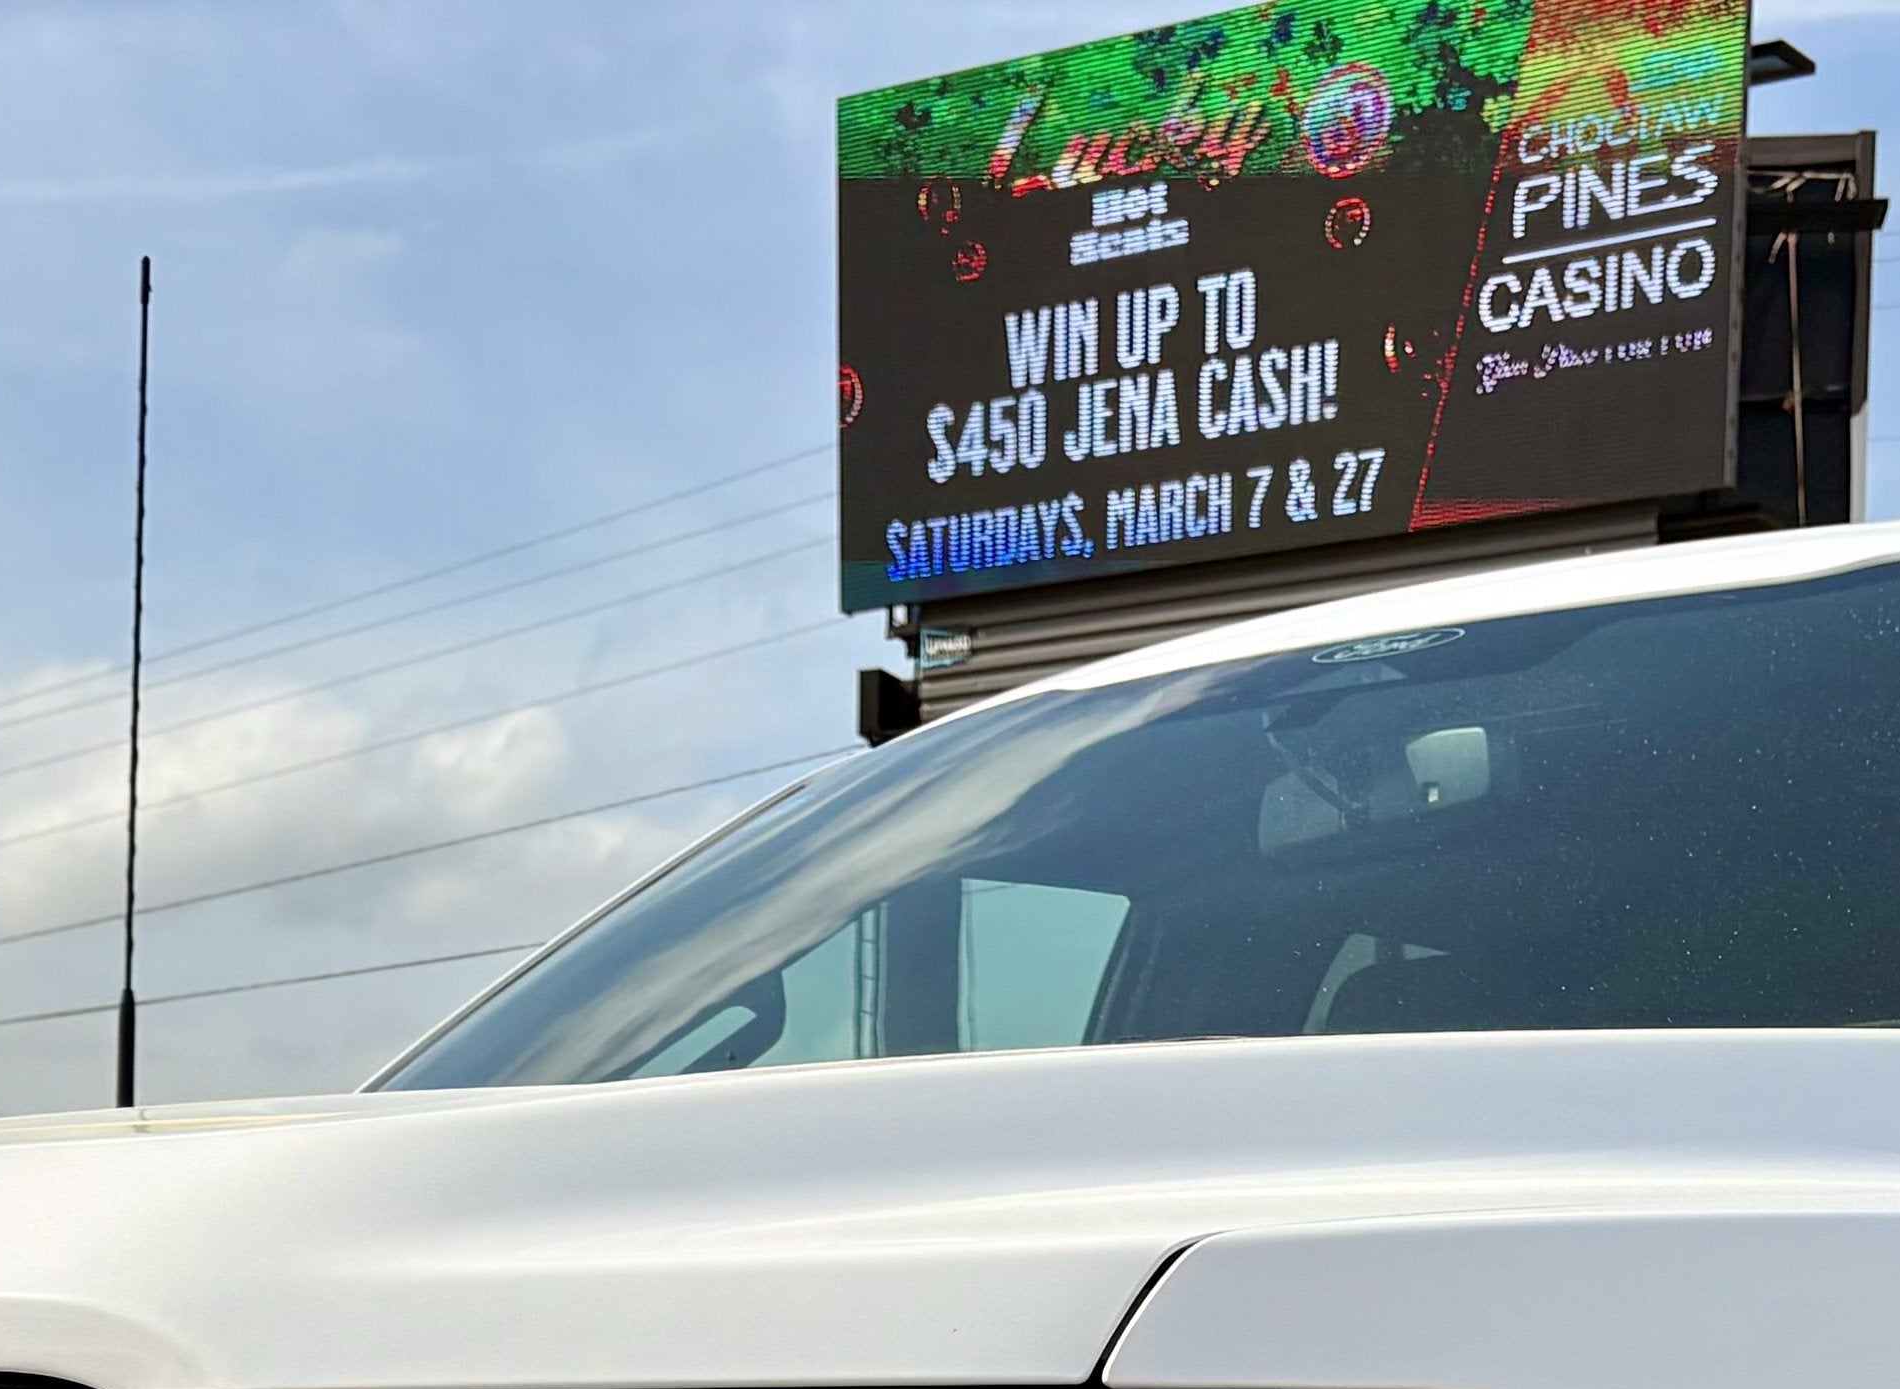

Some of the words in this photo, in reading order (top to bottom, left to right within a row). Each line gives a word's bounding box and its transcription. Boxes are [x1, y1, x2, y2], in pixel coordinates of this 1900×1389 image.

[985, 68, 1273, 197] Lucky
[1512, 142, 1719, 238] PINES
[1517, 97, 1722, 164] CHOCTAW
[1004, 298, 1100, 389] WIN
[1116, 283, 1180, 368] UP
[1197, 268, 1257, 354] TO
[1478, 238, 1716, 333] CASINO
[926, 390, 1048, 484] $450
[1063, 368, 1181, 462] JENA
[1198, 339, 1339, 440] CASH!
[885, 491, 1095, 582] SATURDAYS,
[1105, 471, 1233, 550] MARCH
[1246, 466, 1274, 529] 7
[1286, 457, 1318, 523] &
[1333, 448, 1386, 516] 27
